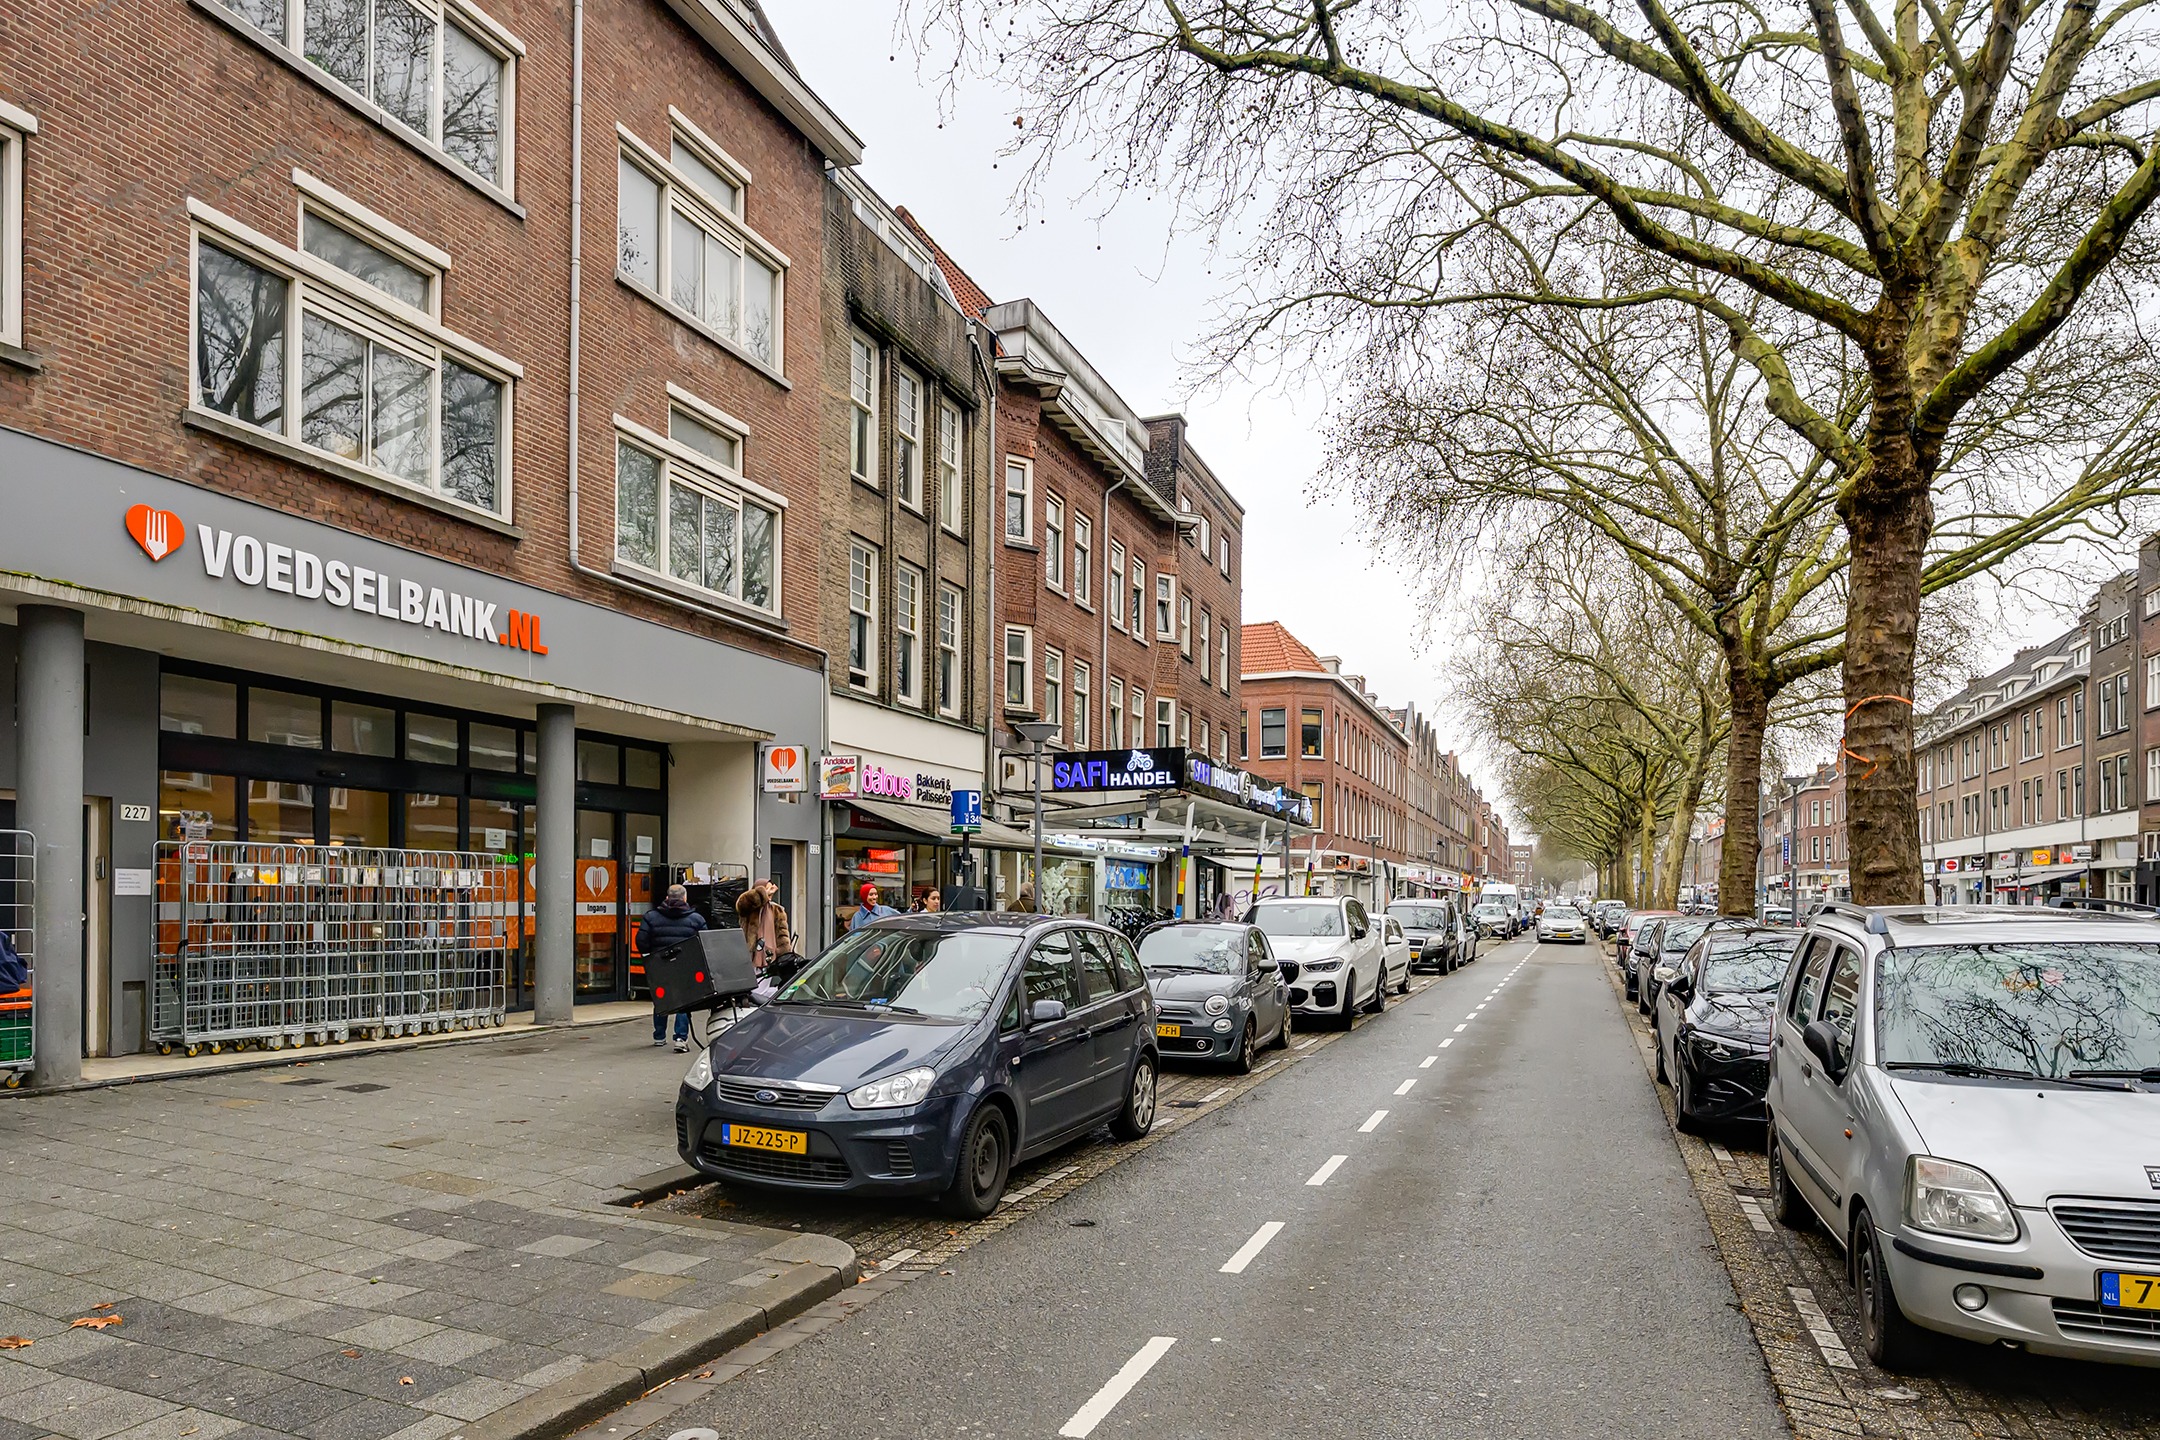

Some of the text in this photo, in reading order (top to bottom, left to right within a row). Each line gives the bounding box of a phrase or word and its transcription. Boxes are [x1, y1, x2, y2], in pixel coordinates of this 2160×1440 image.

[197, 523, 549, 656] VOEDSELBANK.NL
[823, 757, 855, 766] Andalous
[862, 764, 911, 799] dalous
[1054, 761, 1176, 789] SAFI HANDEL
[1192, 759, 1211, 786] SAFI
[916, 773, 951, 794] Bakkerij &
[916, 788, 951, 805] Patisserie
[968, 792, 980, 812] P
[124, 806, 147, 819] 227
[586, 903, 607, 914] Ingang
[1157, 1025, 1177, 1035] 7-FH
[735, 1128, 799, 1150] JZ-225-P
[2103, 1292, 2118, 1301] NL
